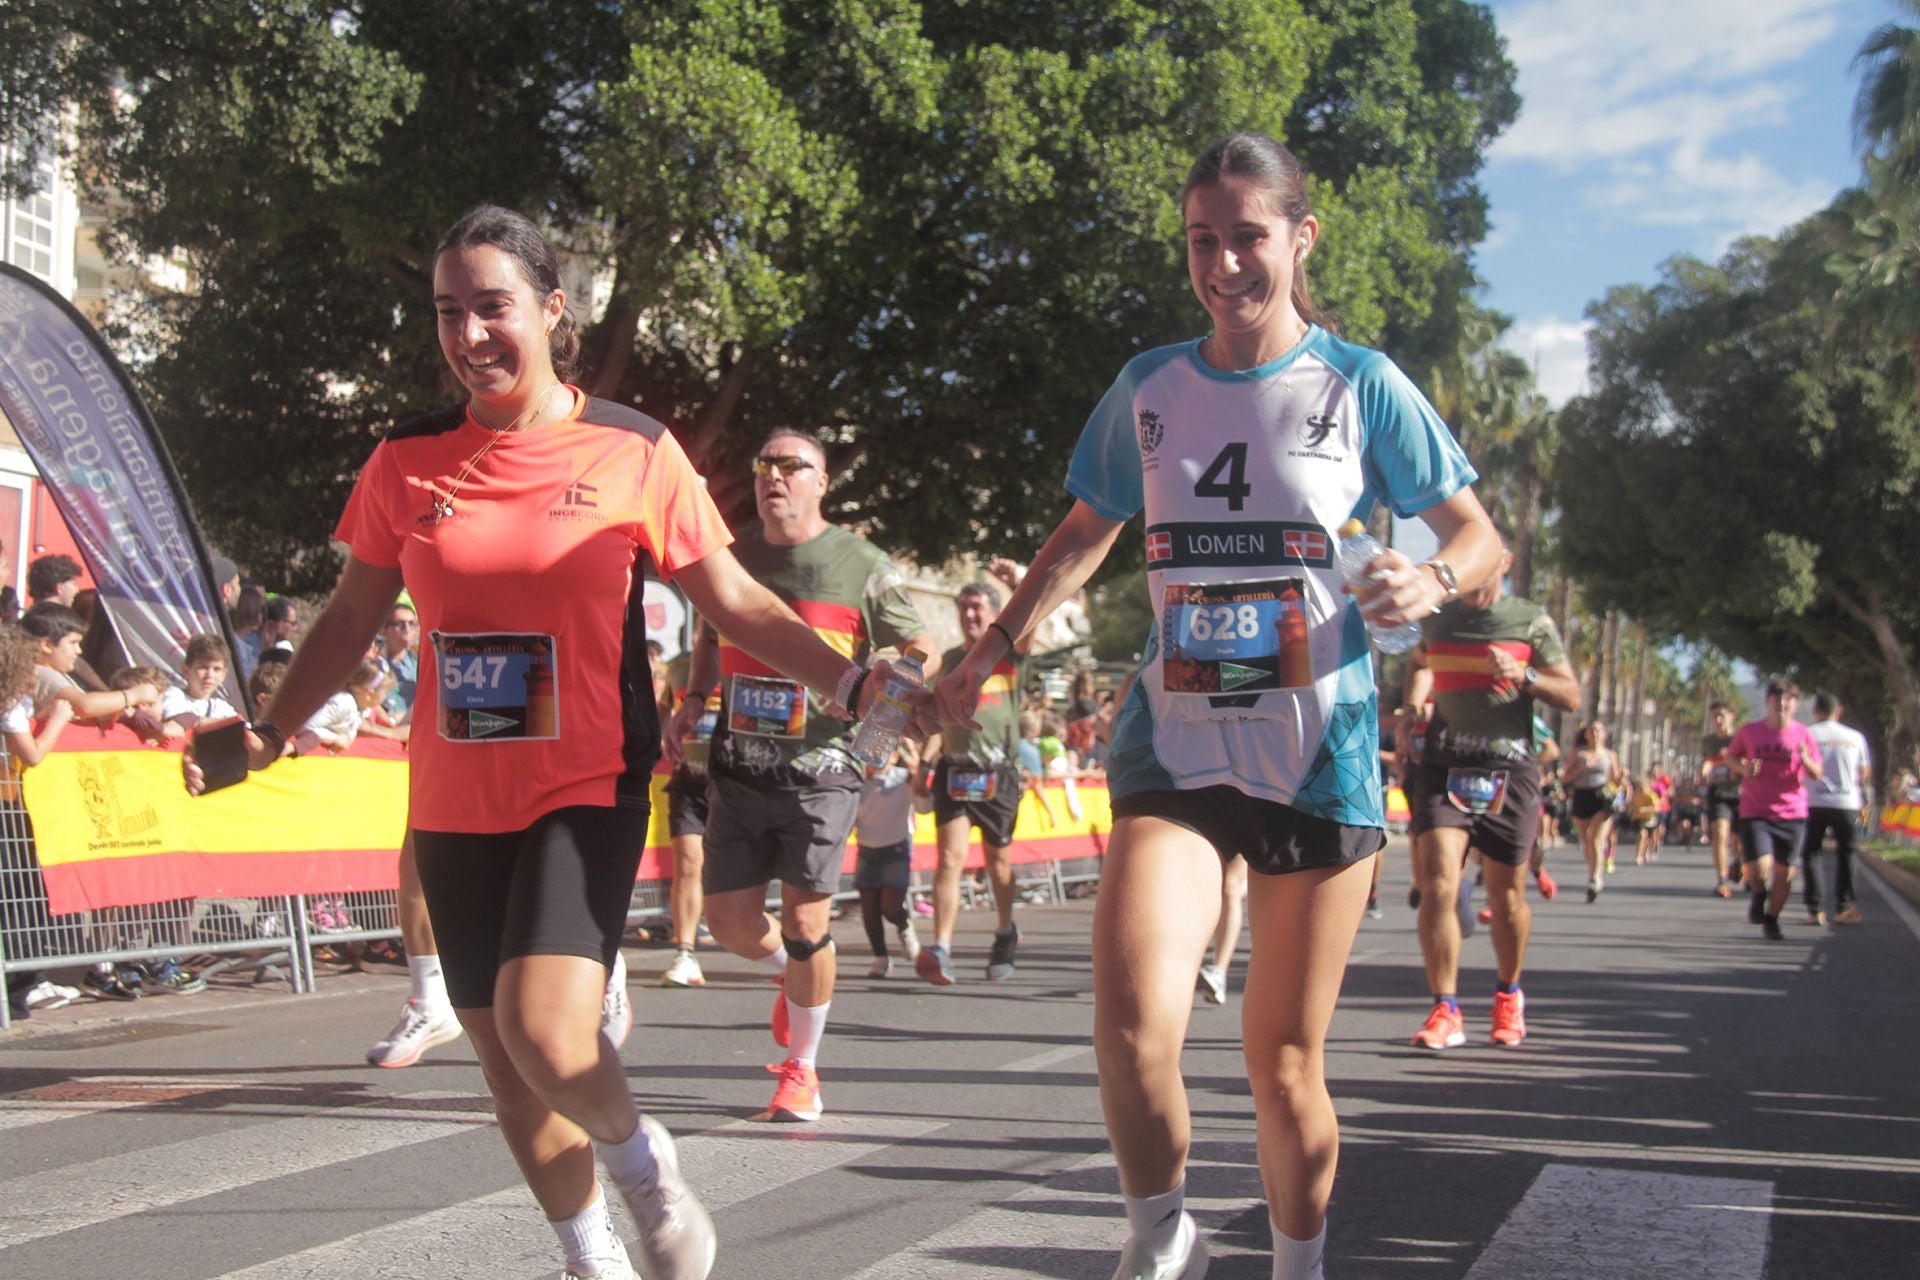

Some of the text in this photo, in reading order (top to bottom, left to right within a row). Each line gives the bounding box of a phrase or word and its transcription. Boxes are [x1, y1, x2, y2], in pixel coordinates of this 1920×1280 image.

[1193, 442, 1251, 511] 4
[1188, 533, 1265, 554] LOMEN
[1190, 605, 1260, 641] 628
[444, 656, 507, 690] 547
[742, 688, 787, 710] 1152
